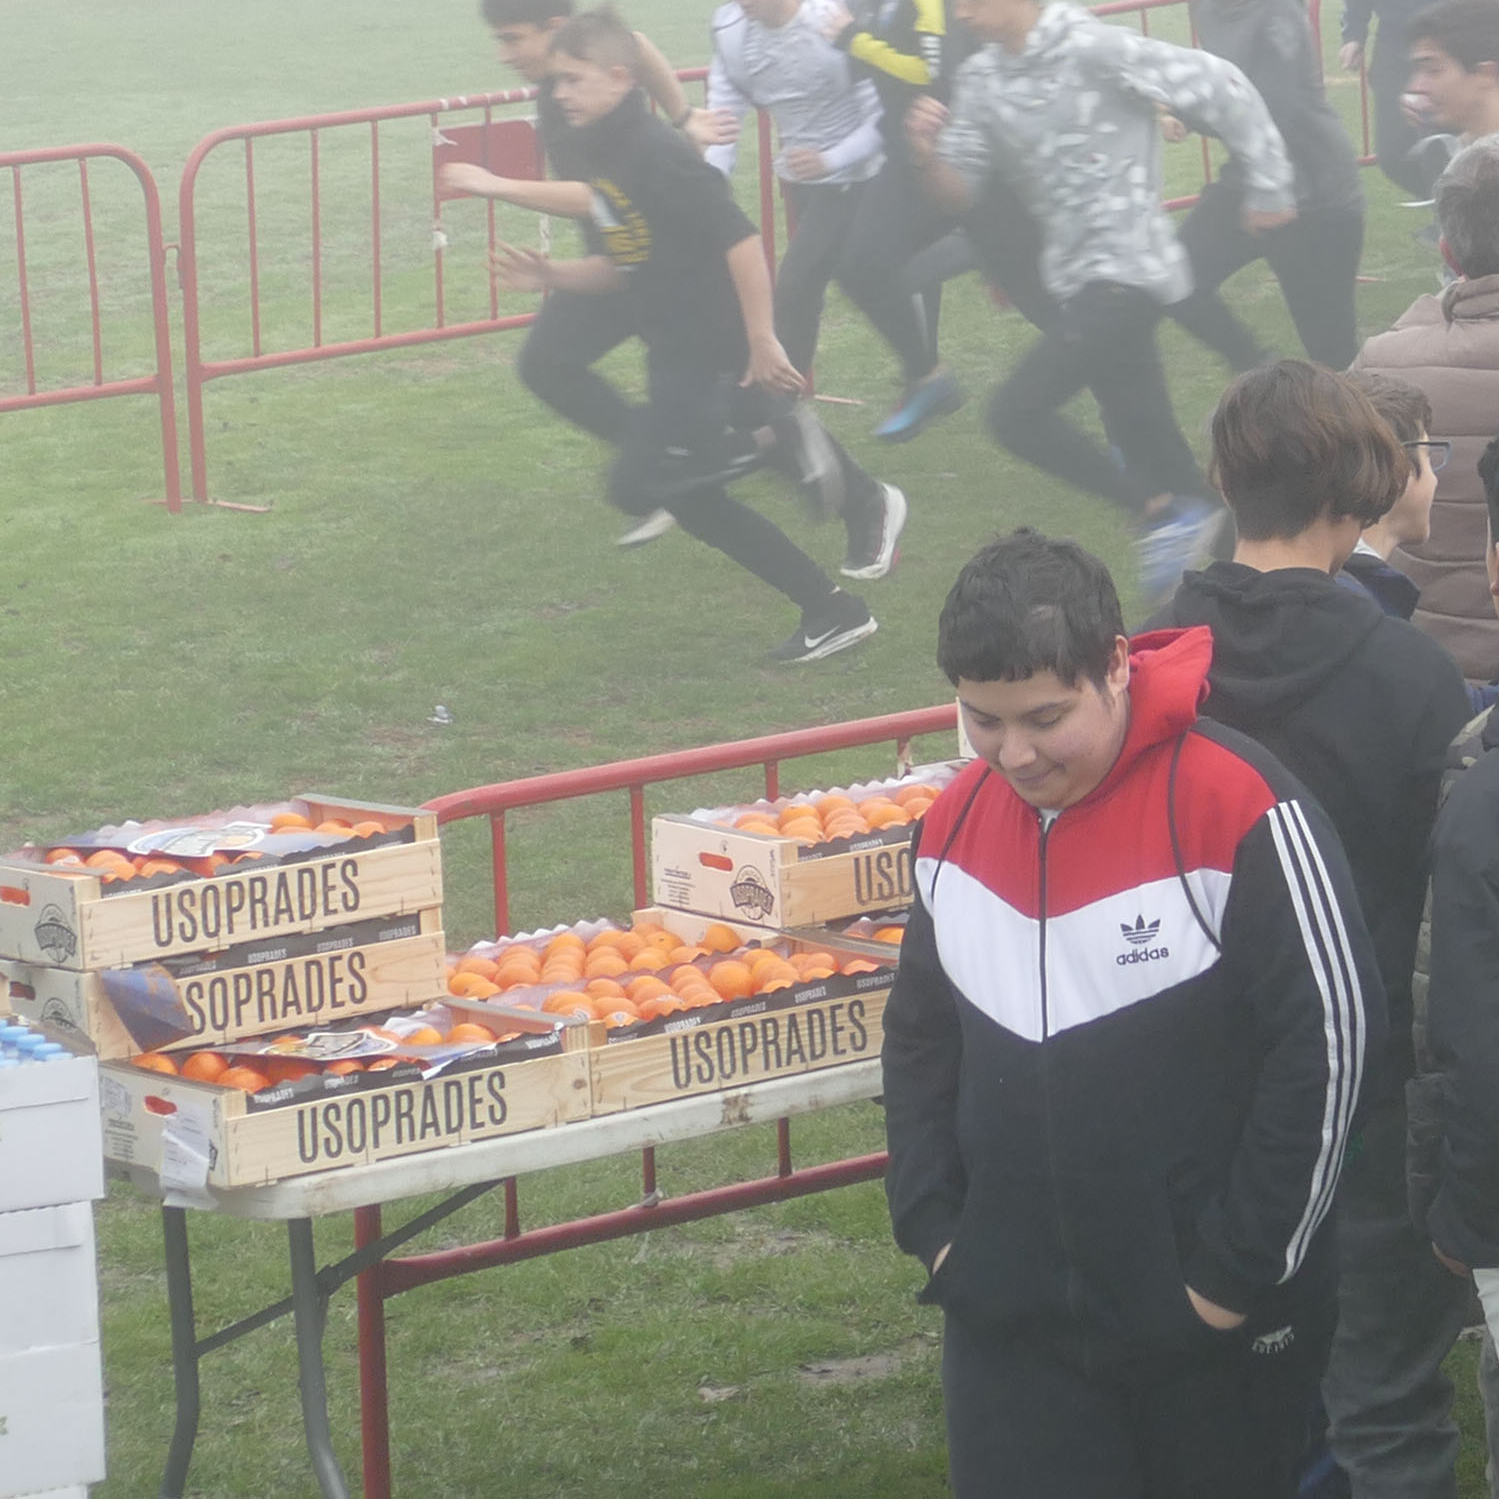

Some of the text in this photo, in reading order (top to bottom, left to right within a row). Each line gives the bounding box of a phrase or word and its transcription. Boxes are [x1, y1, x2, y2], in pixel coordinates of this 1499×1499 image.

[152, 859, 361, 948] USOPRADES
[853, 847, 915, 906] USO
[186, 951, 368, 1035] SOPRADES
[1116, 947, 1169, 965] adidas
[670, 999, 868, 1091] USOPRADES
[298, 1070, 508, 1163] USOPRADES
